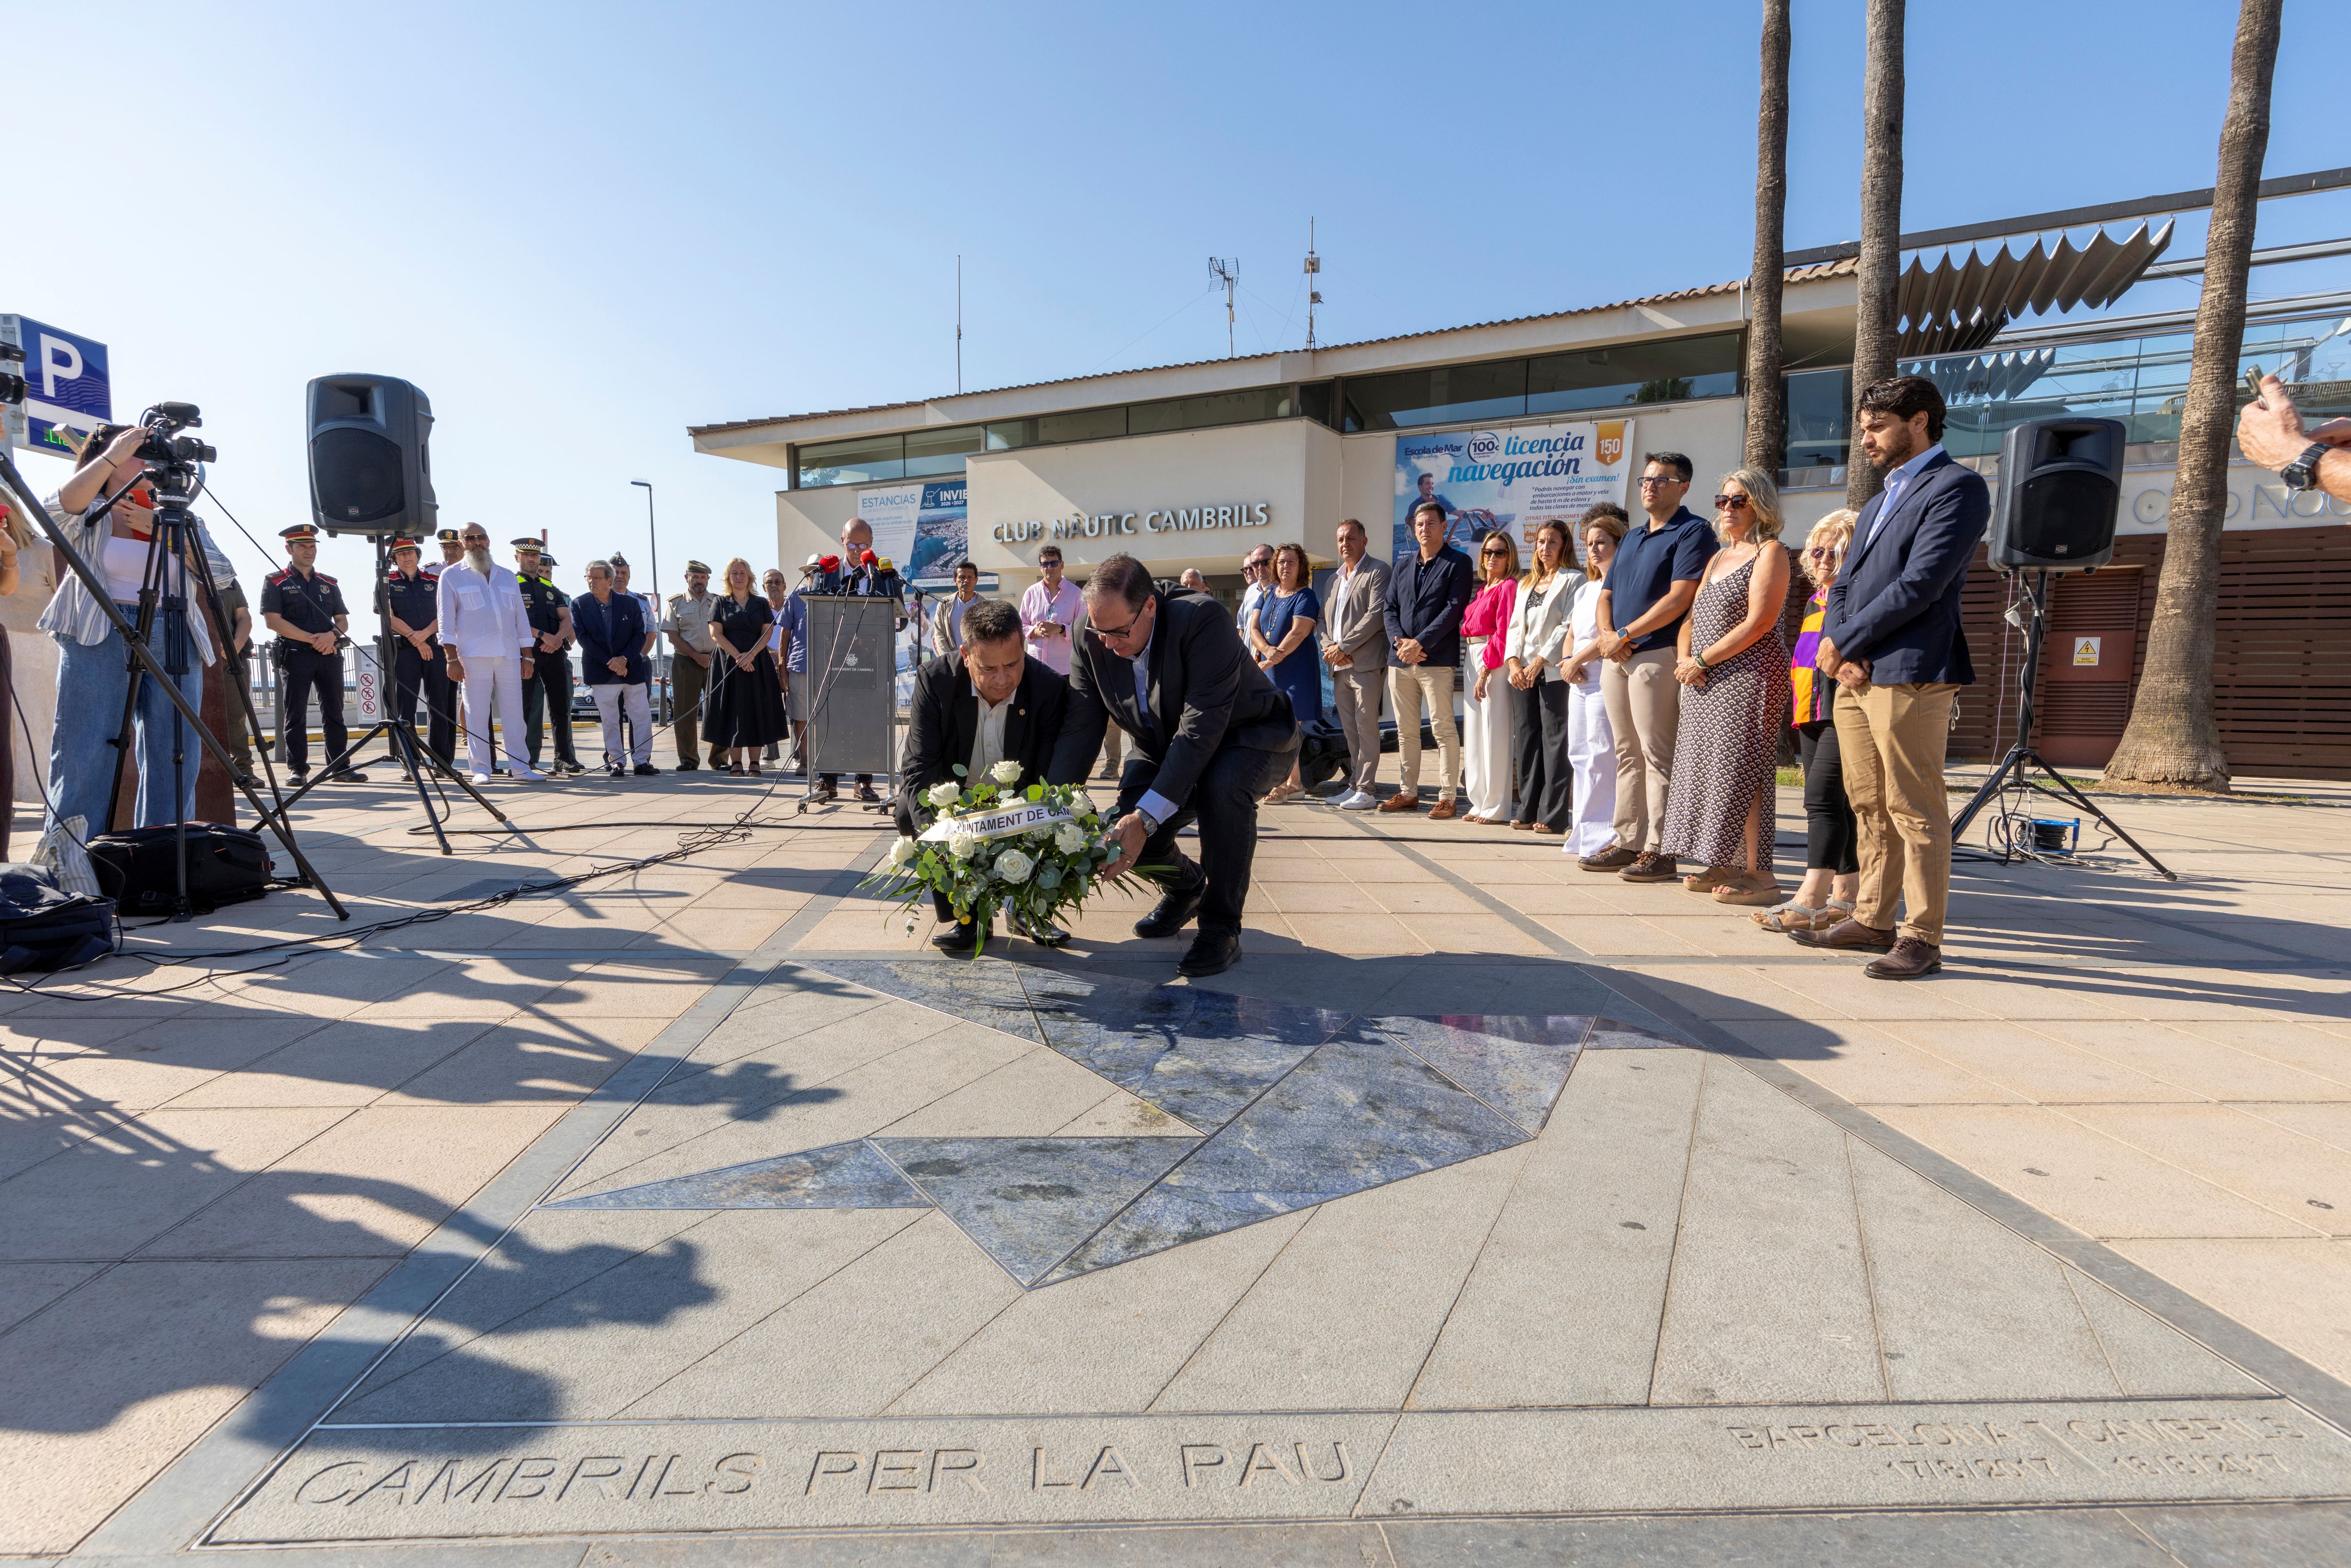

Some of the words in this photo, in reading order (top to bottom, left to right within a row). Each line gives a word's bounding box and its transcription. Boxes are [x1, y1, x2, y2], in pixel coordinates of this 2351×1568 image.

[39, 332, 83, 398] P
[1404, 446, 1430, 456] Escola
[1432, 445, 1443, 454] de
[1505, 432, 1585, 456] licencia
[1600, 438, 1620, 455] 150
[1585, 473, 1619, 482] examen!
[862, 494, 916, 508] ESTANCIAS
[991, 520, 1043, 544] CLUB
[1145, 503, 1269, 533] CAMBRILS
[1027, 808, 1045, 822] DE
[1048, 807, 1074, 817] CAM
[1727, 1422, 2028, 1450] BARCELONA
[2067, 1417, 2306, 1442] CAMBRILS
[294, 1452, 765, 1506] CAMBRILS
[805, 1448, 988, 1496] PER
[1033, 1445, 1143, 1492] LA
[1180, 1441, 1354, 1489] PAU
